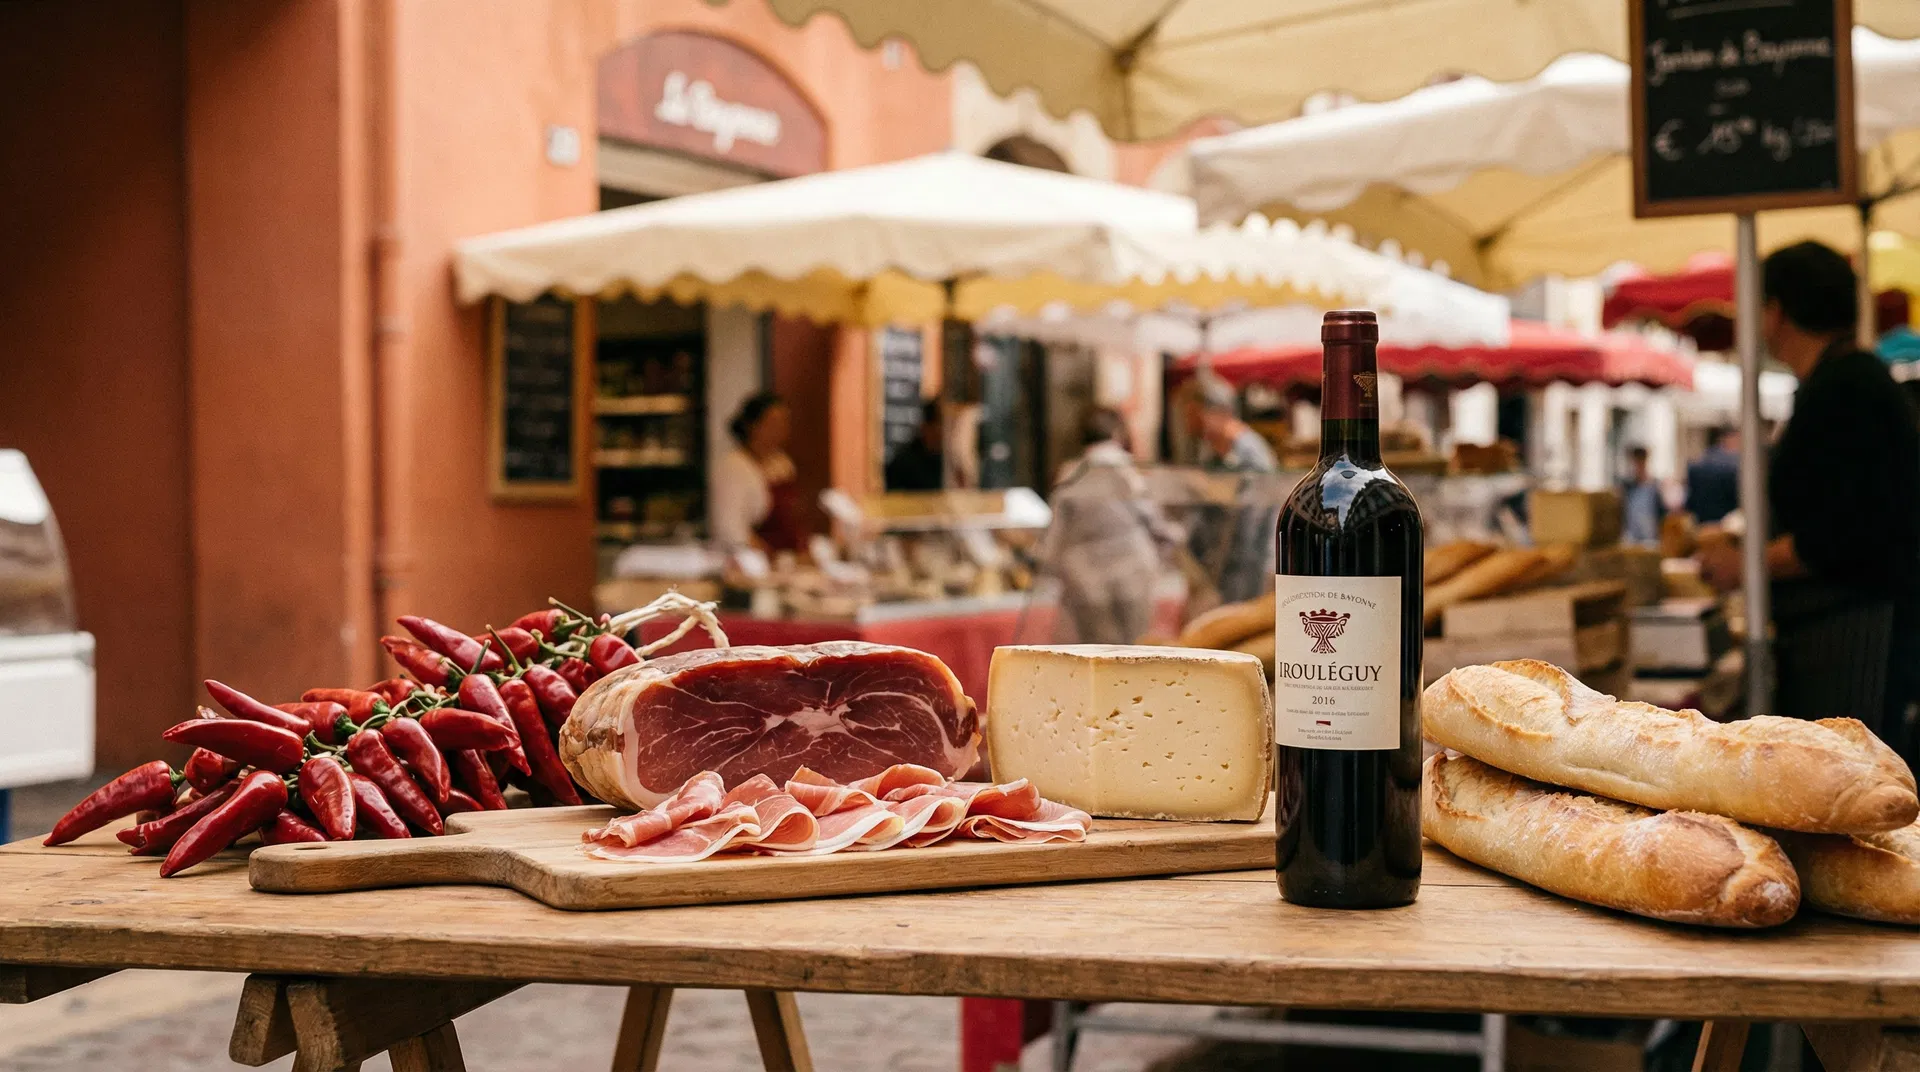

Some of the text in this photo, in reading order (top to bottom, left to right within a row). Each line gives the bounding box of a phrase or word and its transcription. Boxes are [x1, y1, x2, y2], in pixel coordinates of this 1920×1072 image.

[1327, 591, 1338, 600] DE
[1340, 592, 1378, 610] BAYONNE
[1279, 661, 1382, 682] IROULÉGUY
[1311, 695, 1336, 706] 2016
